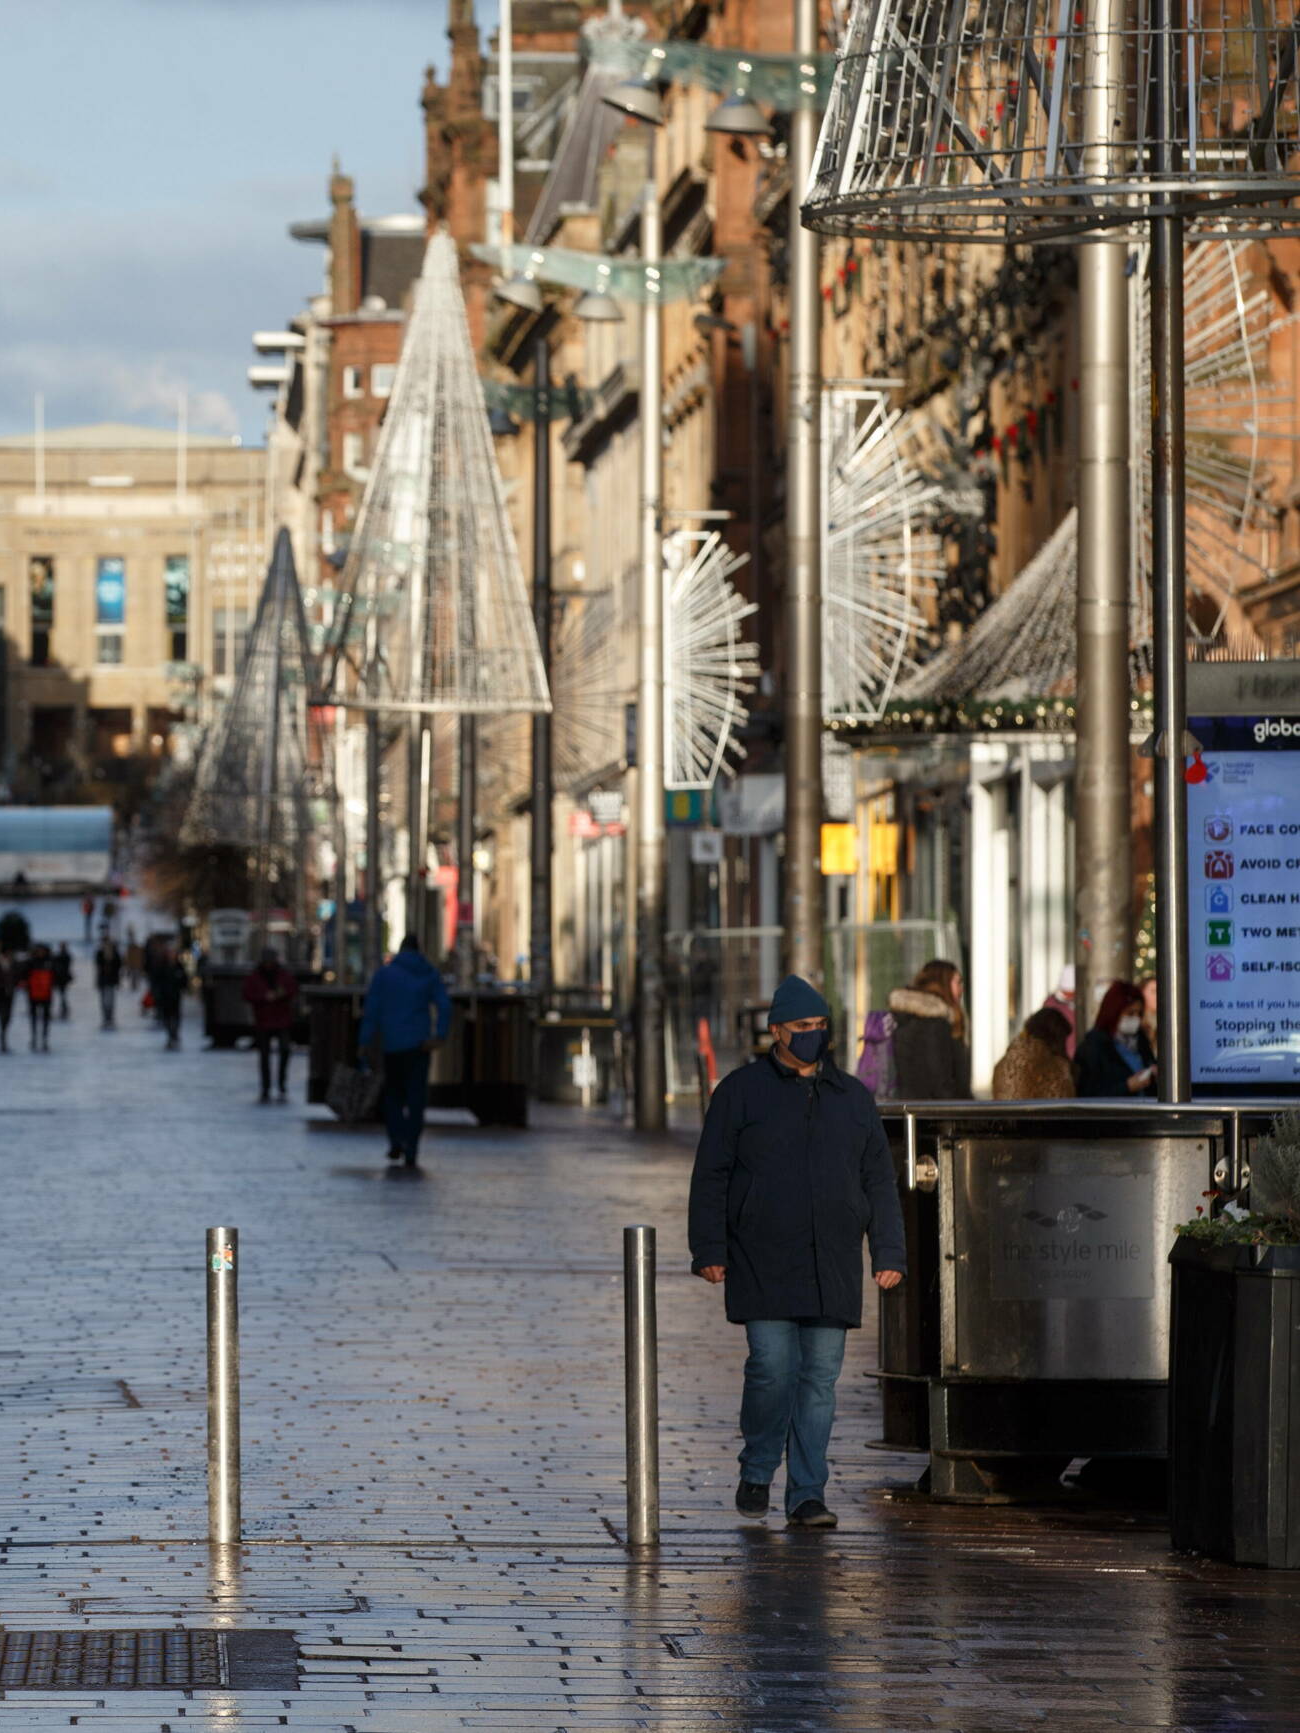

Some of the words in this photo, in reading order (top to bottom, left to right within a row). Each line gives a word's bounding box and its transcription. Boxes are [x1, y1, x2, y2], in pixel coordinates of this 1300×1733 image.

[1239, 824, 1275, 835] FACE
[1279, 824, 1300, 835] CO
[1239, 858, 1281, 870] AVOID
[1240, 893, 1286, 905] CLEAN
[1241, 927, 1272, 938] TWO
[1200, 999, 1224, 1010] Book
[1227, 1001, 1234, 1010] a
[1236, 1000, 1254, 1010] test
[1266, 1001, 1286, 1013] you
[1215, 1017, 1276, 1033] Stopping
[1216, 1035, 1254, 1048] starts
[1258, 1036, 1289, 1048] with
[1003, 1240, 1035, 1261] the
[1038, 1240, 1092, 1265] style
[1097, 1240, 1141, 1261] mile
